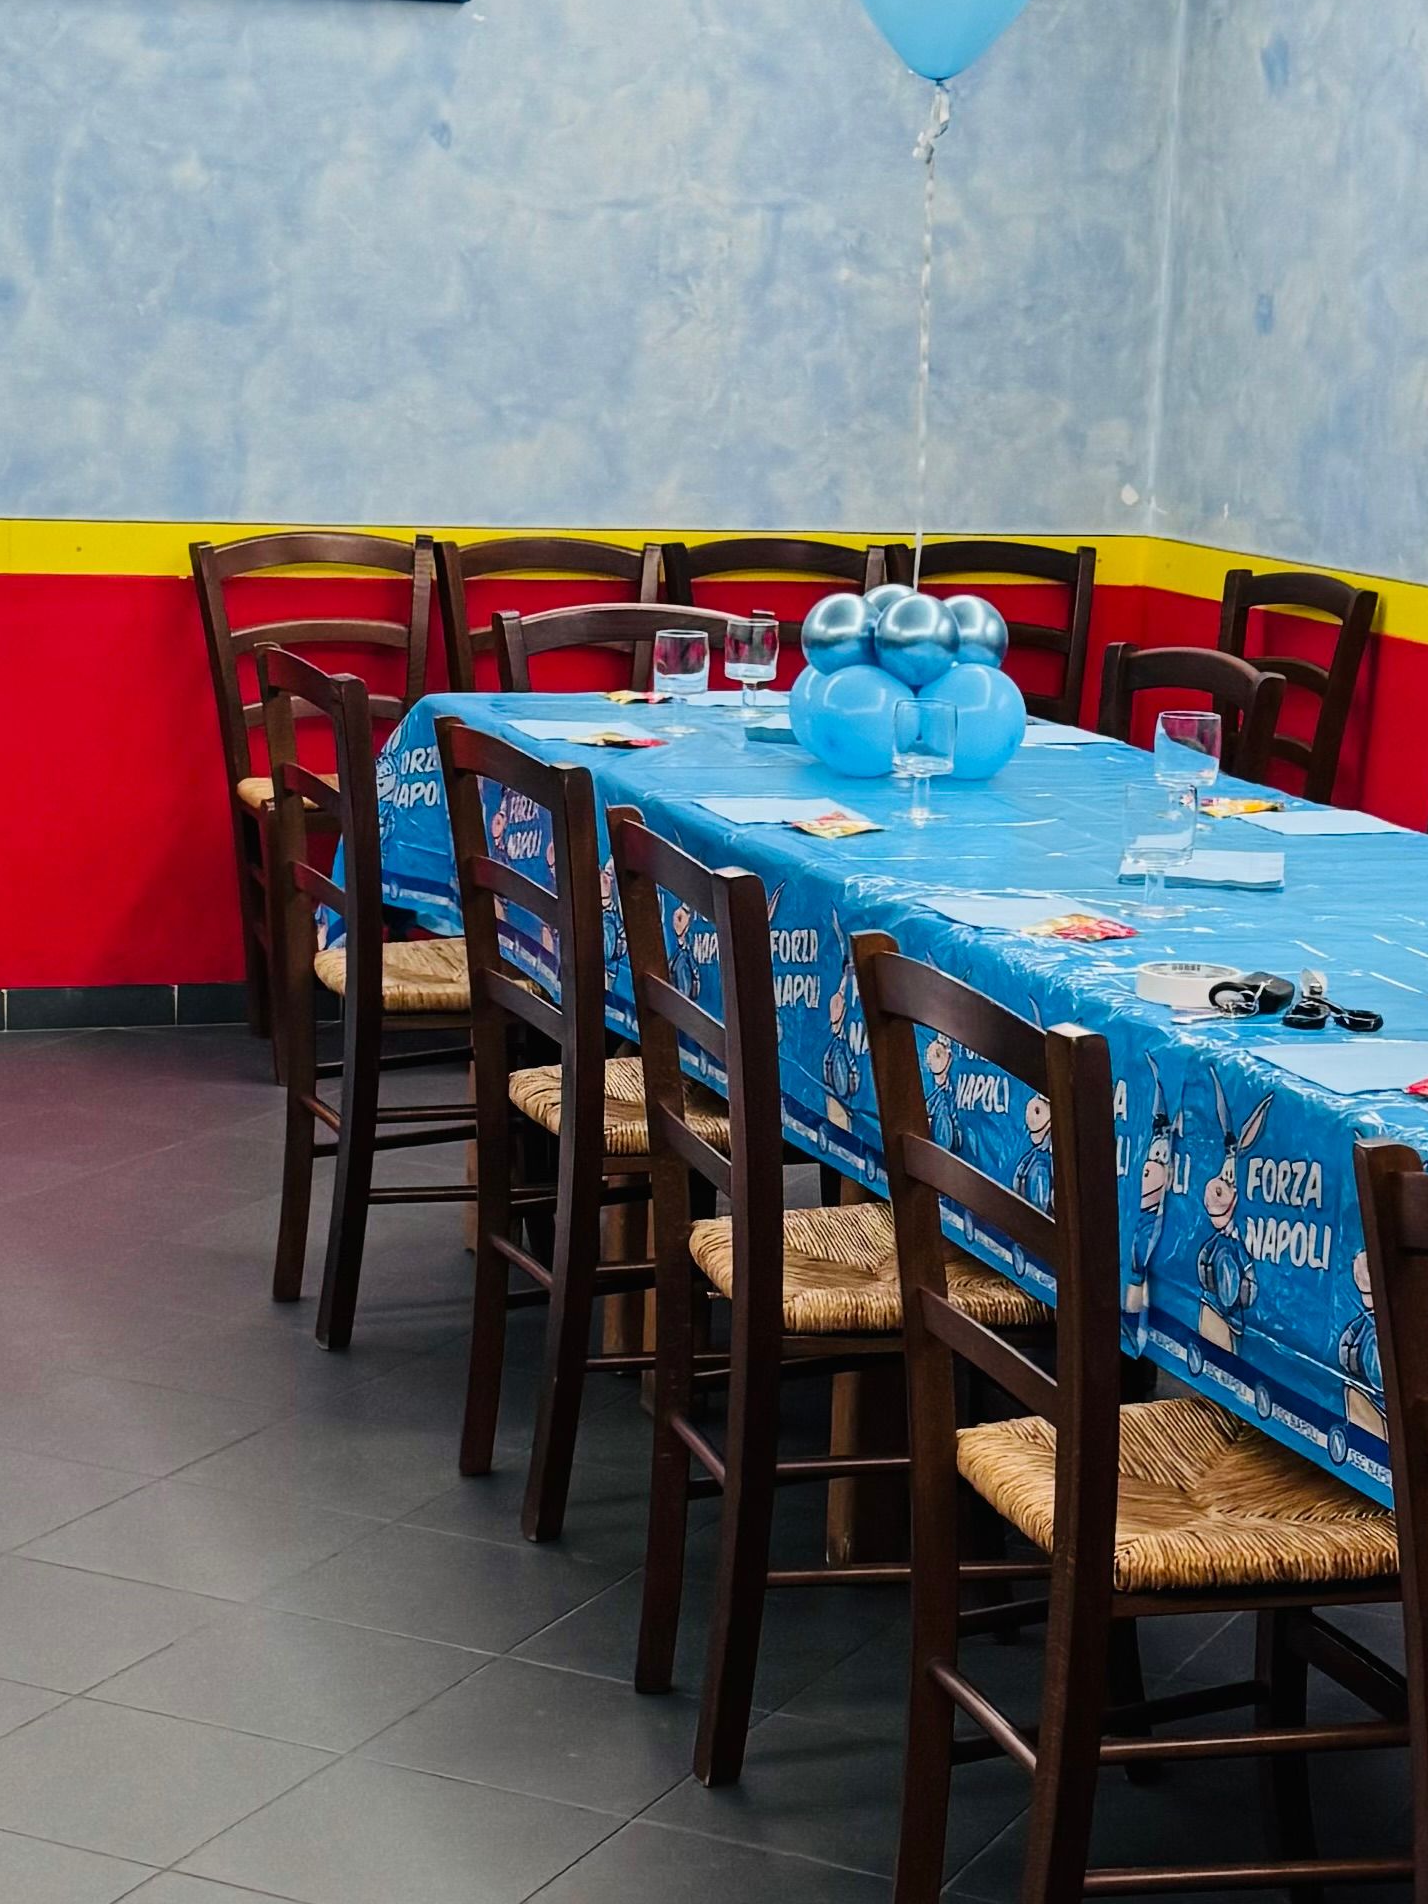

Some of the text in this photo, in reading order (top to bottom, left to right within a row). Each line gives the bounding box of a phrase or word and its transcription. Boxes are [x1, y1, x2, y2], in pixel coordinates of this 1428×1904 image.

[770, 929, 819, 963] FORZA
[773, 974, 820, 1008] NAPOLI
[956, 1073, 1010, 1114] NAPOLI
[1246, 1157, 1323, 1209] FORZA
[1244, 1217, 1332, 1271] NAPOLI
